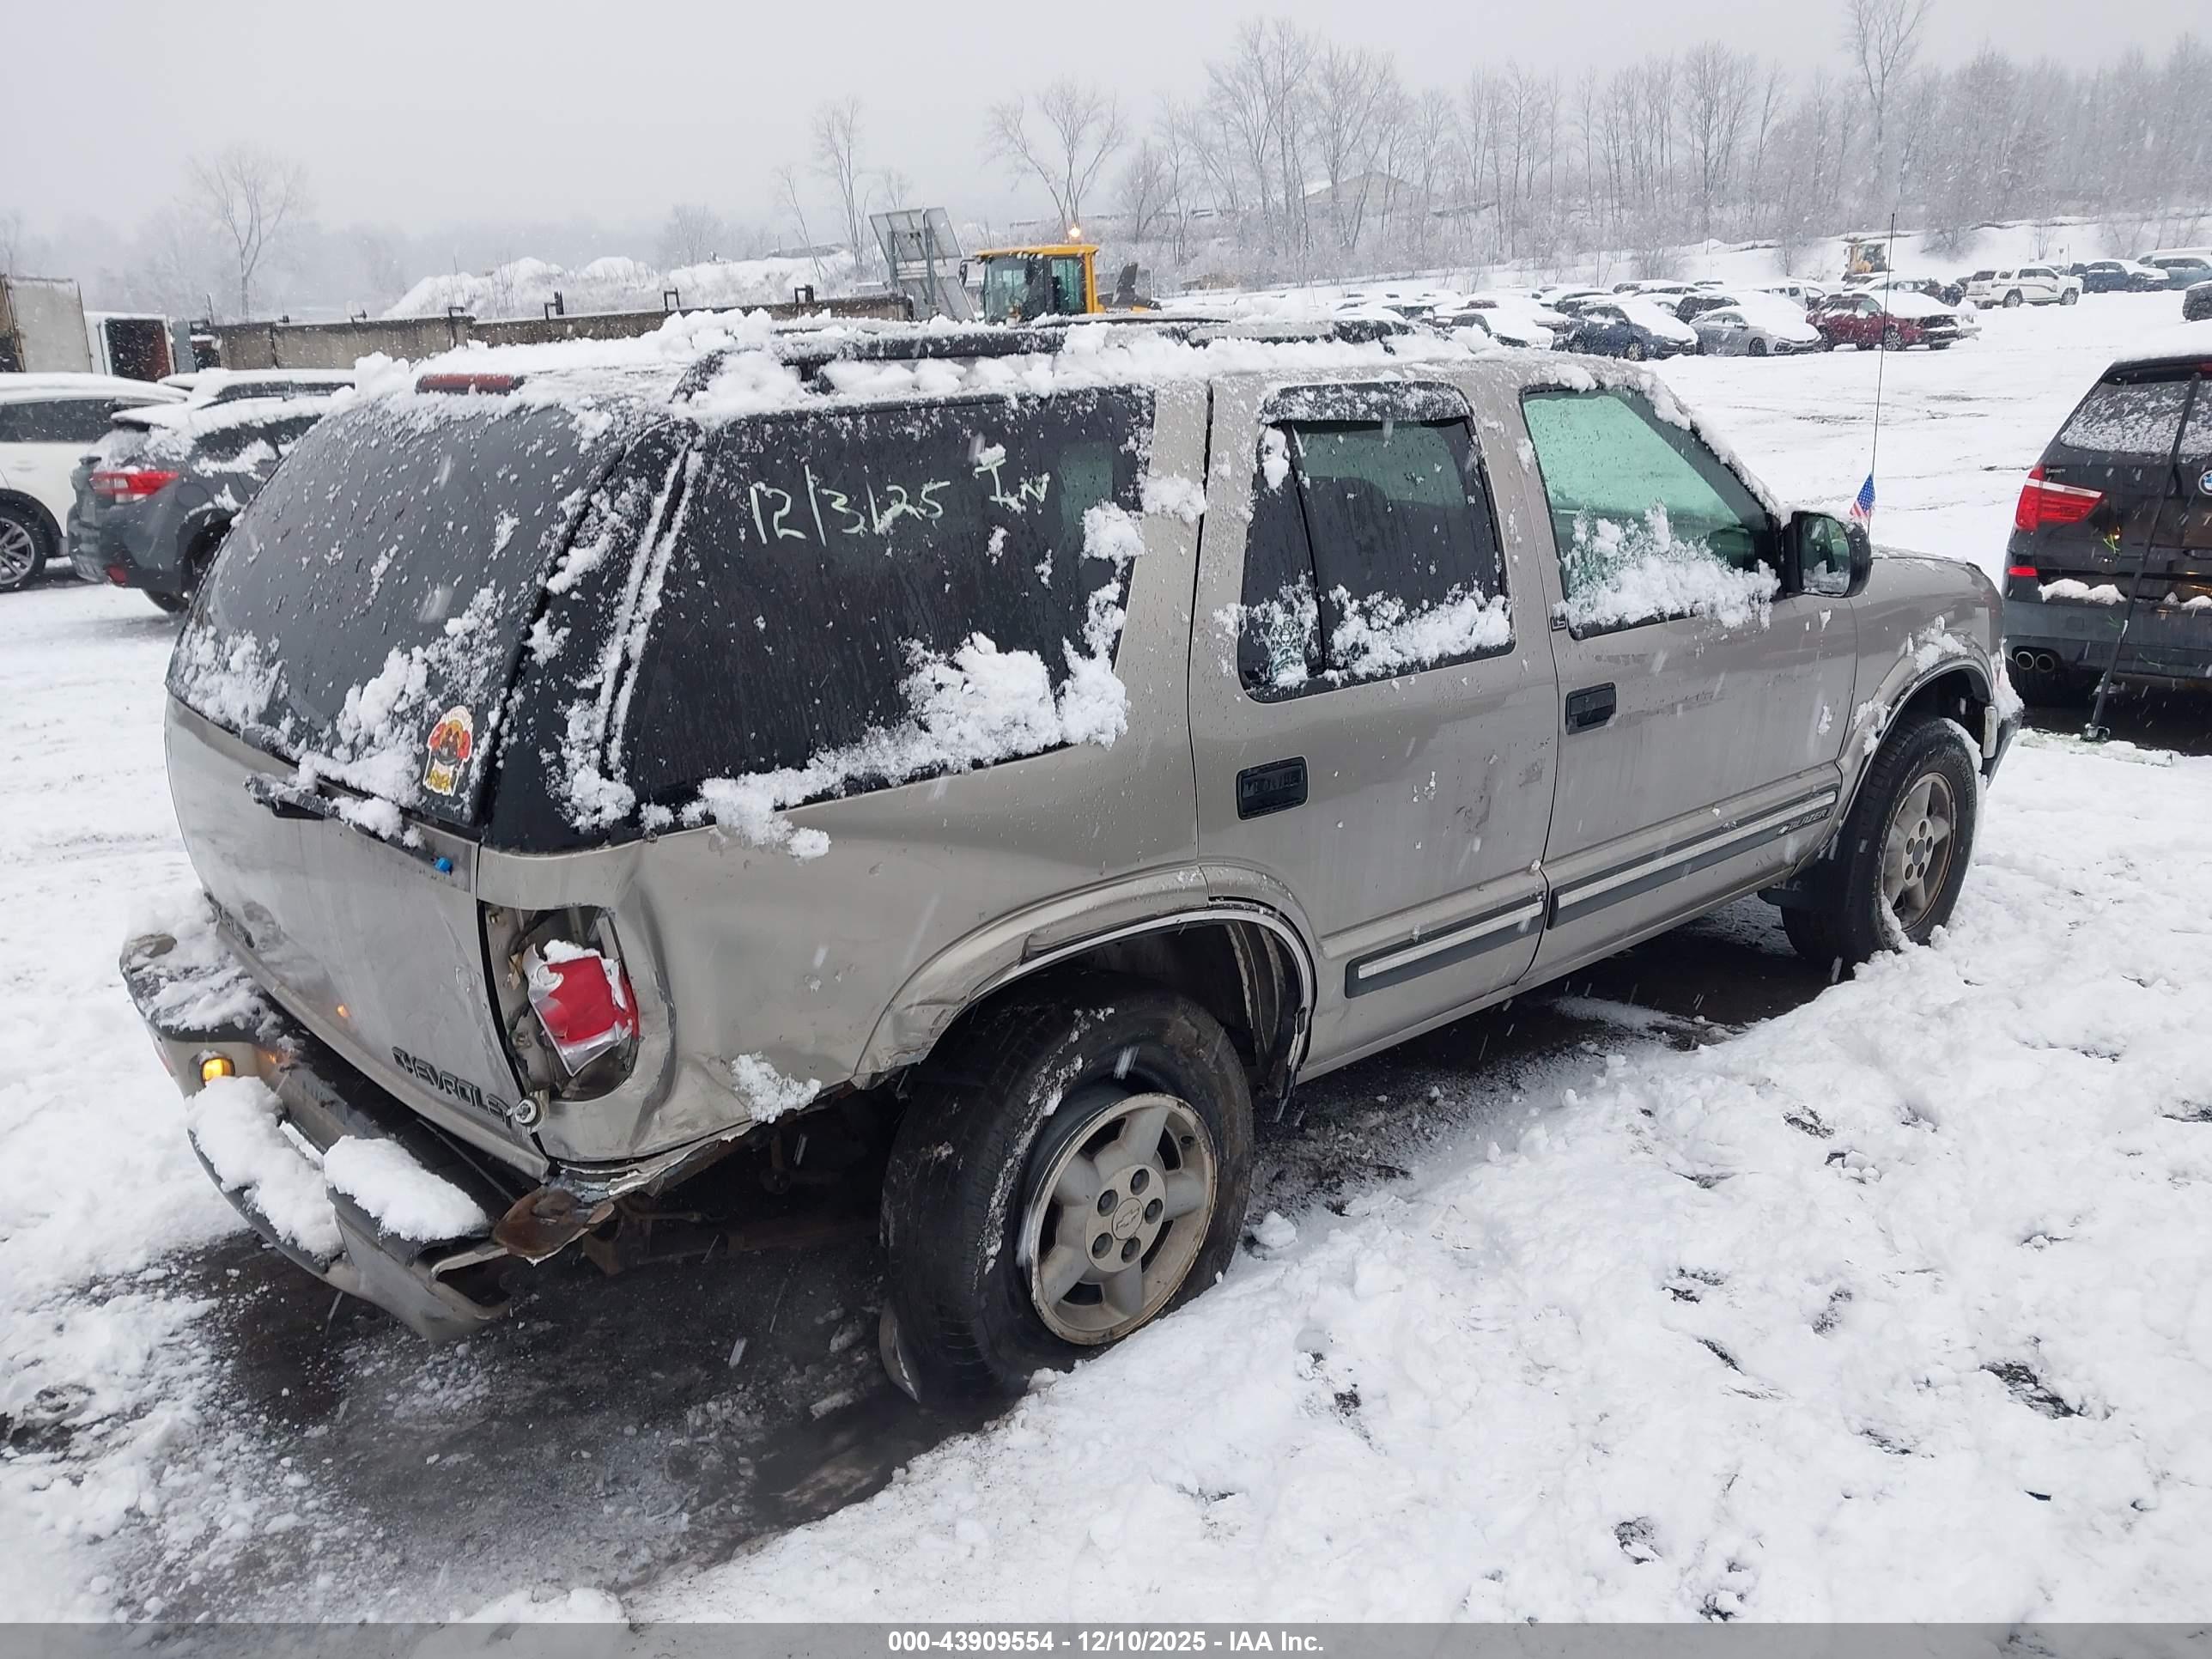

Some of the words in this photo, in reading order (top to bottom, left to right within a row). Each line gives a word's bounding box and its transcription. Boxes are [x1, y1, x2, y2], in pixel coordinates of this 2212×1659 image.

[750, 464, 951, 547] 12/3/25
[1551, 617, 1566, 630] LS
[391, 1046, 513, 1128] CHEVROLET
